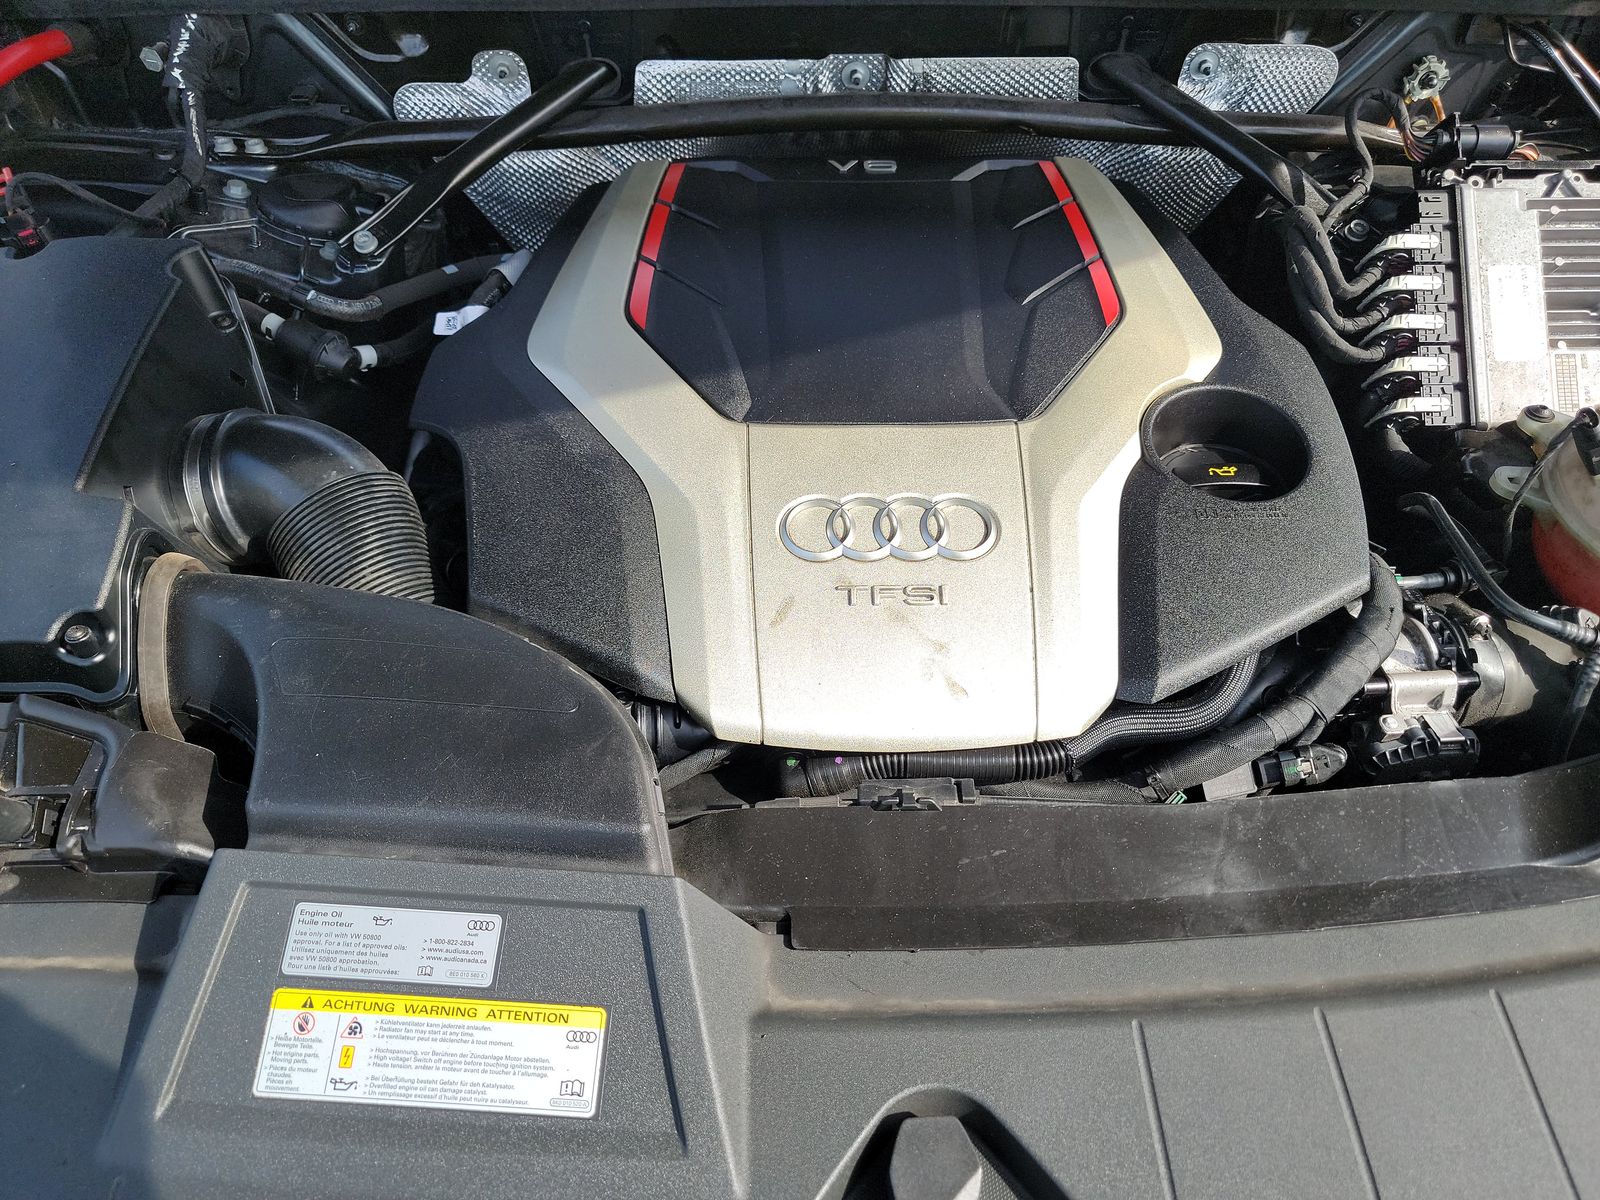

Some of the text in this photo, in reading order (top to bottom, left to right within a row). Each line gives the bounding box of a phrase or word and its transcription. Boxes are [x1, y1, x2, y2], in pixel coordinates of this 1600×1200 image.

[827, 159, 897, 174] V6
[834, 584, 949, 606] TFSI
[299, 909, 343, 918] Engine Oil
[297, 918, 354, 928] Huile moteur
[308, 930, 323, 938] only
[427, 947, 484, 956] www.audiusa.com
[426, 955, 487, 964] www.audicanada.ca
[322, 999, 570, 1024] ACHTUNG WARNING ATTENTION
